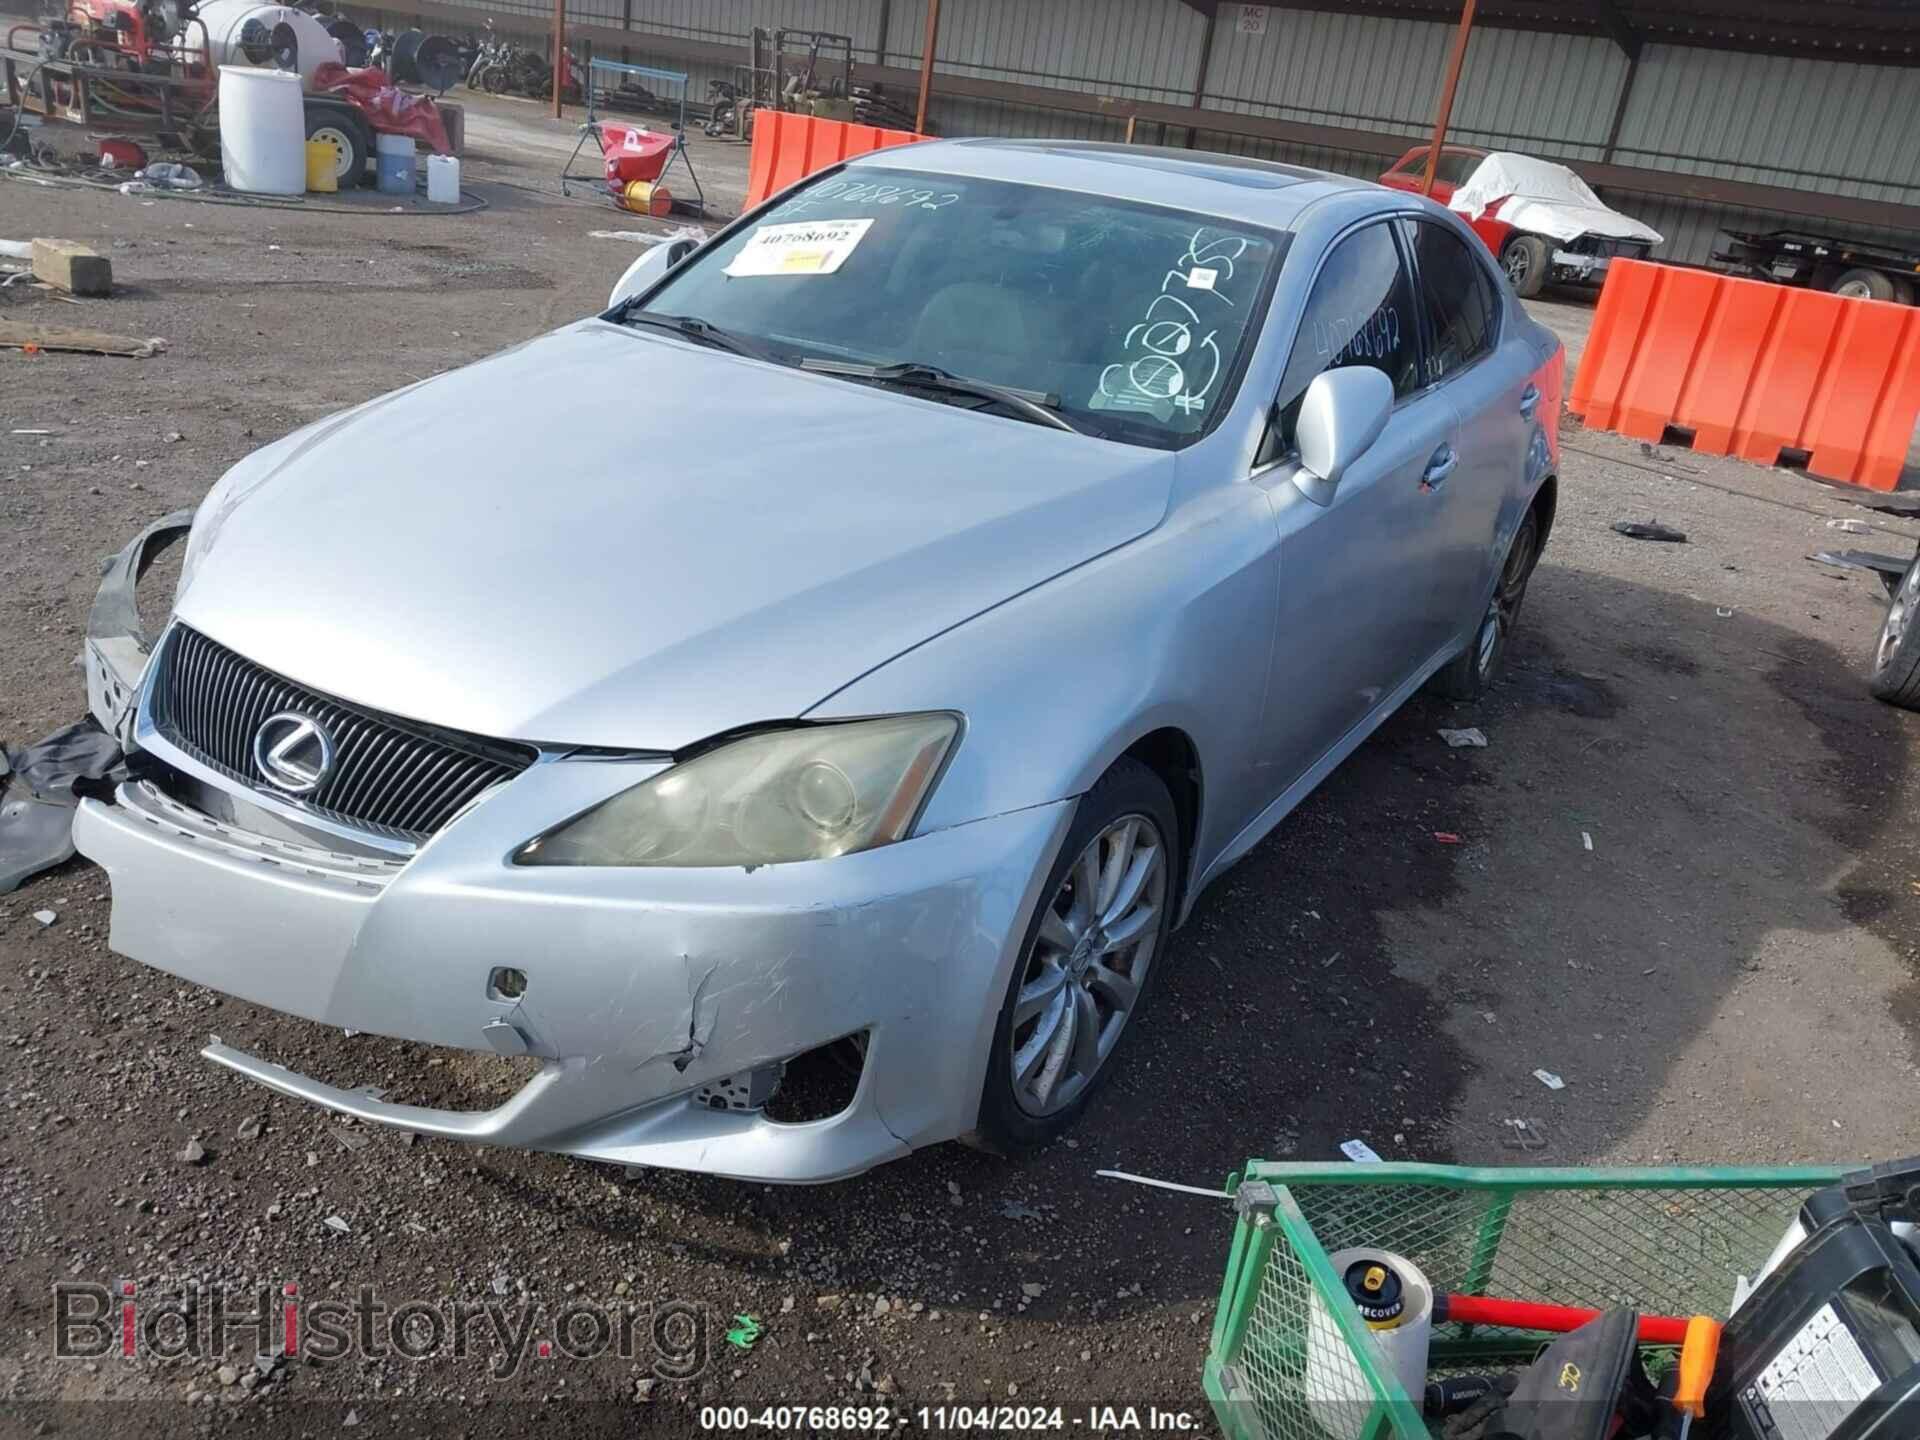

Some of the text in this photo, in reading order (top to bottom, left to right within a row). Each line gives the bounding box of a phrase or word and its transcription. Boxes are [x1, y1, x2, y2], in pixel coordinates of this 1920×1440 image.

[1243, 6, 1264, 17] MC
[1243, 20, 1260, 31] 20
[760, 230, 850, 246] 40768692
